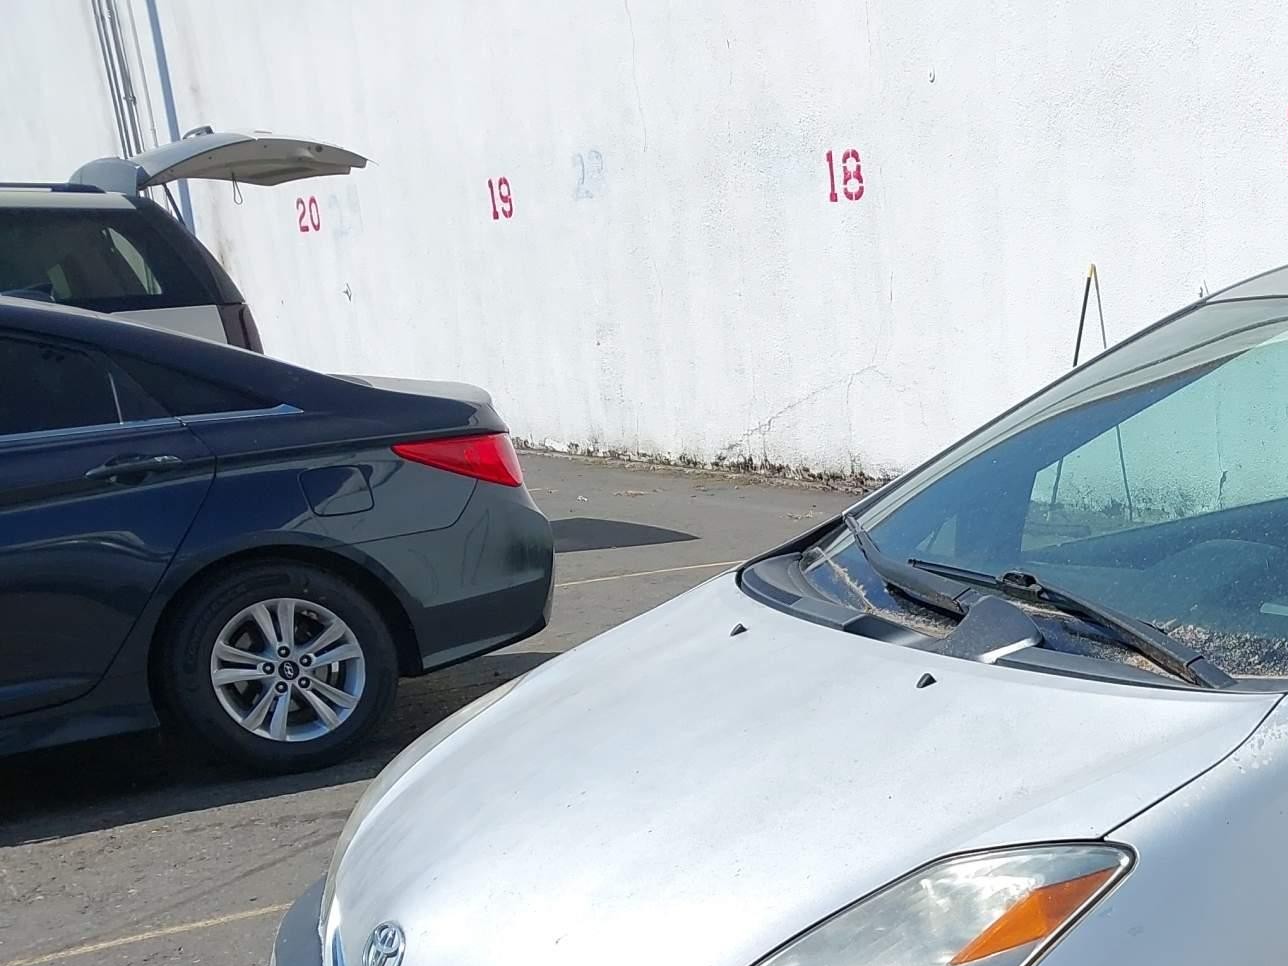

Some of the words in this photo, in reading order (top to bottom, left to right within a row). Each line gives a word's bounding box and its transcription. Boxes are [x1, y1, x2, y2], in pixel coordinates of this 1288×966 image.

[826, 151, 864, 202] 18
[296, 196, 321, 233] 20
[488, 177, 514, 221] 19
